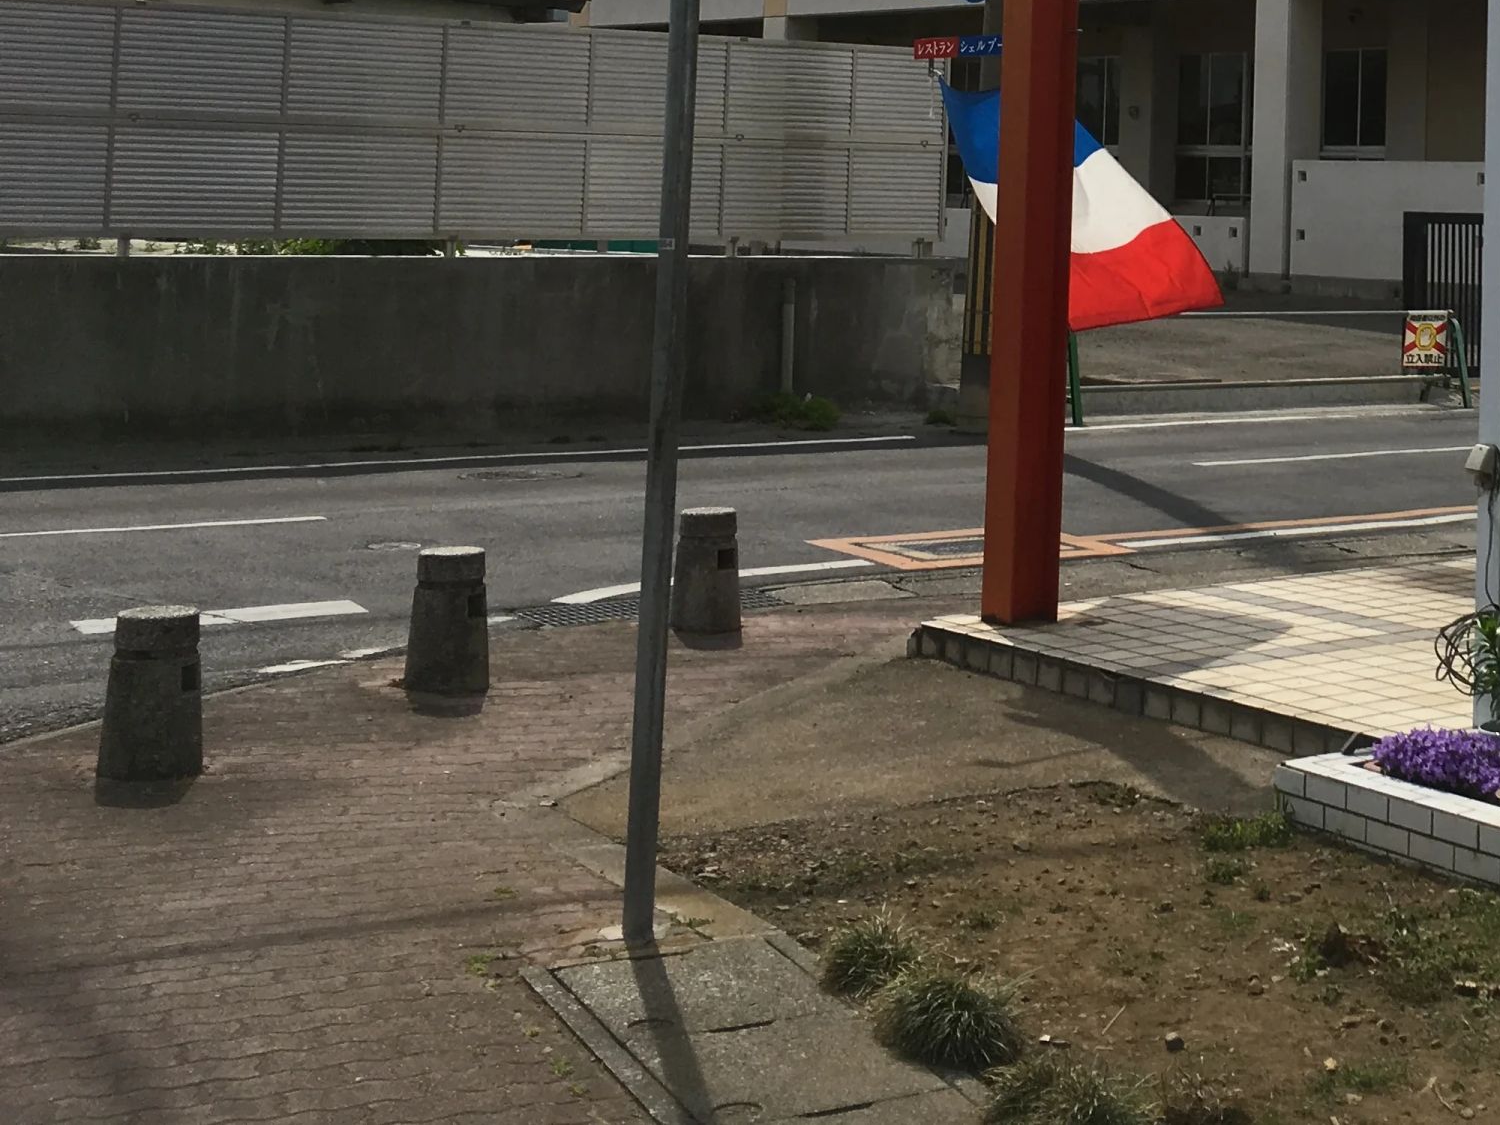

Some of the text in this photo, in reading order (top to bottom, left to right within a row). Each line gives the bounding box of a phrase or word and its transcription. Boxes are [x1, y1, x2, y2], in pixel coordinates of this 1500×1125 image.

[918, 41, 955, 56] レストラン
[1405, 353, 1443, 364] 立入禁止
